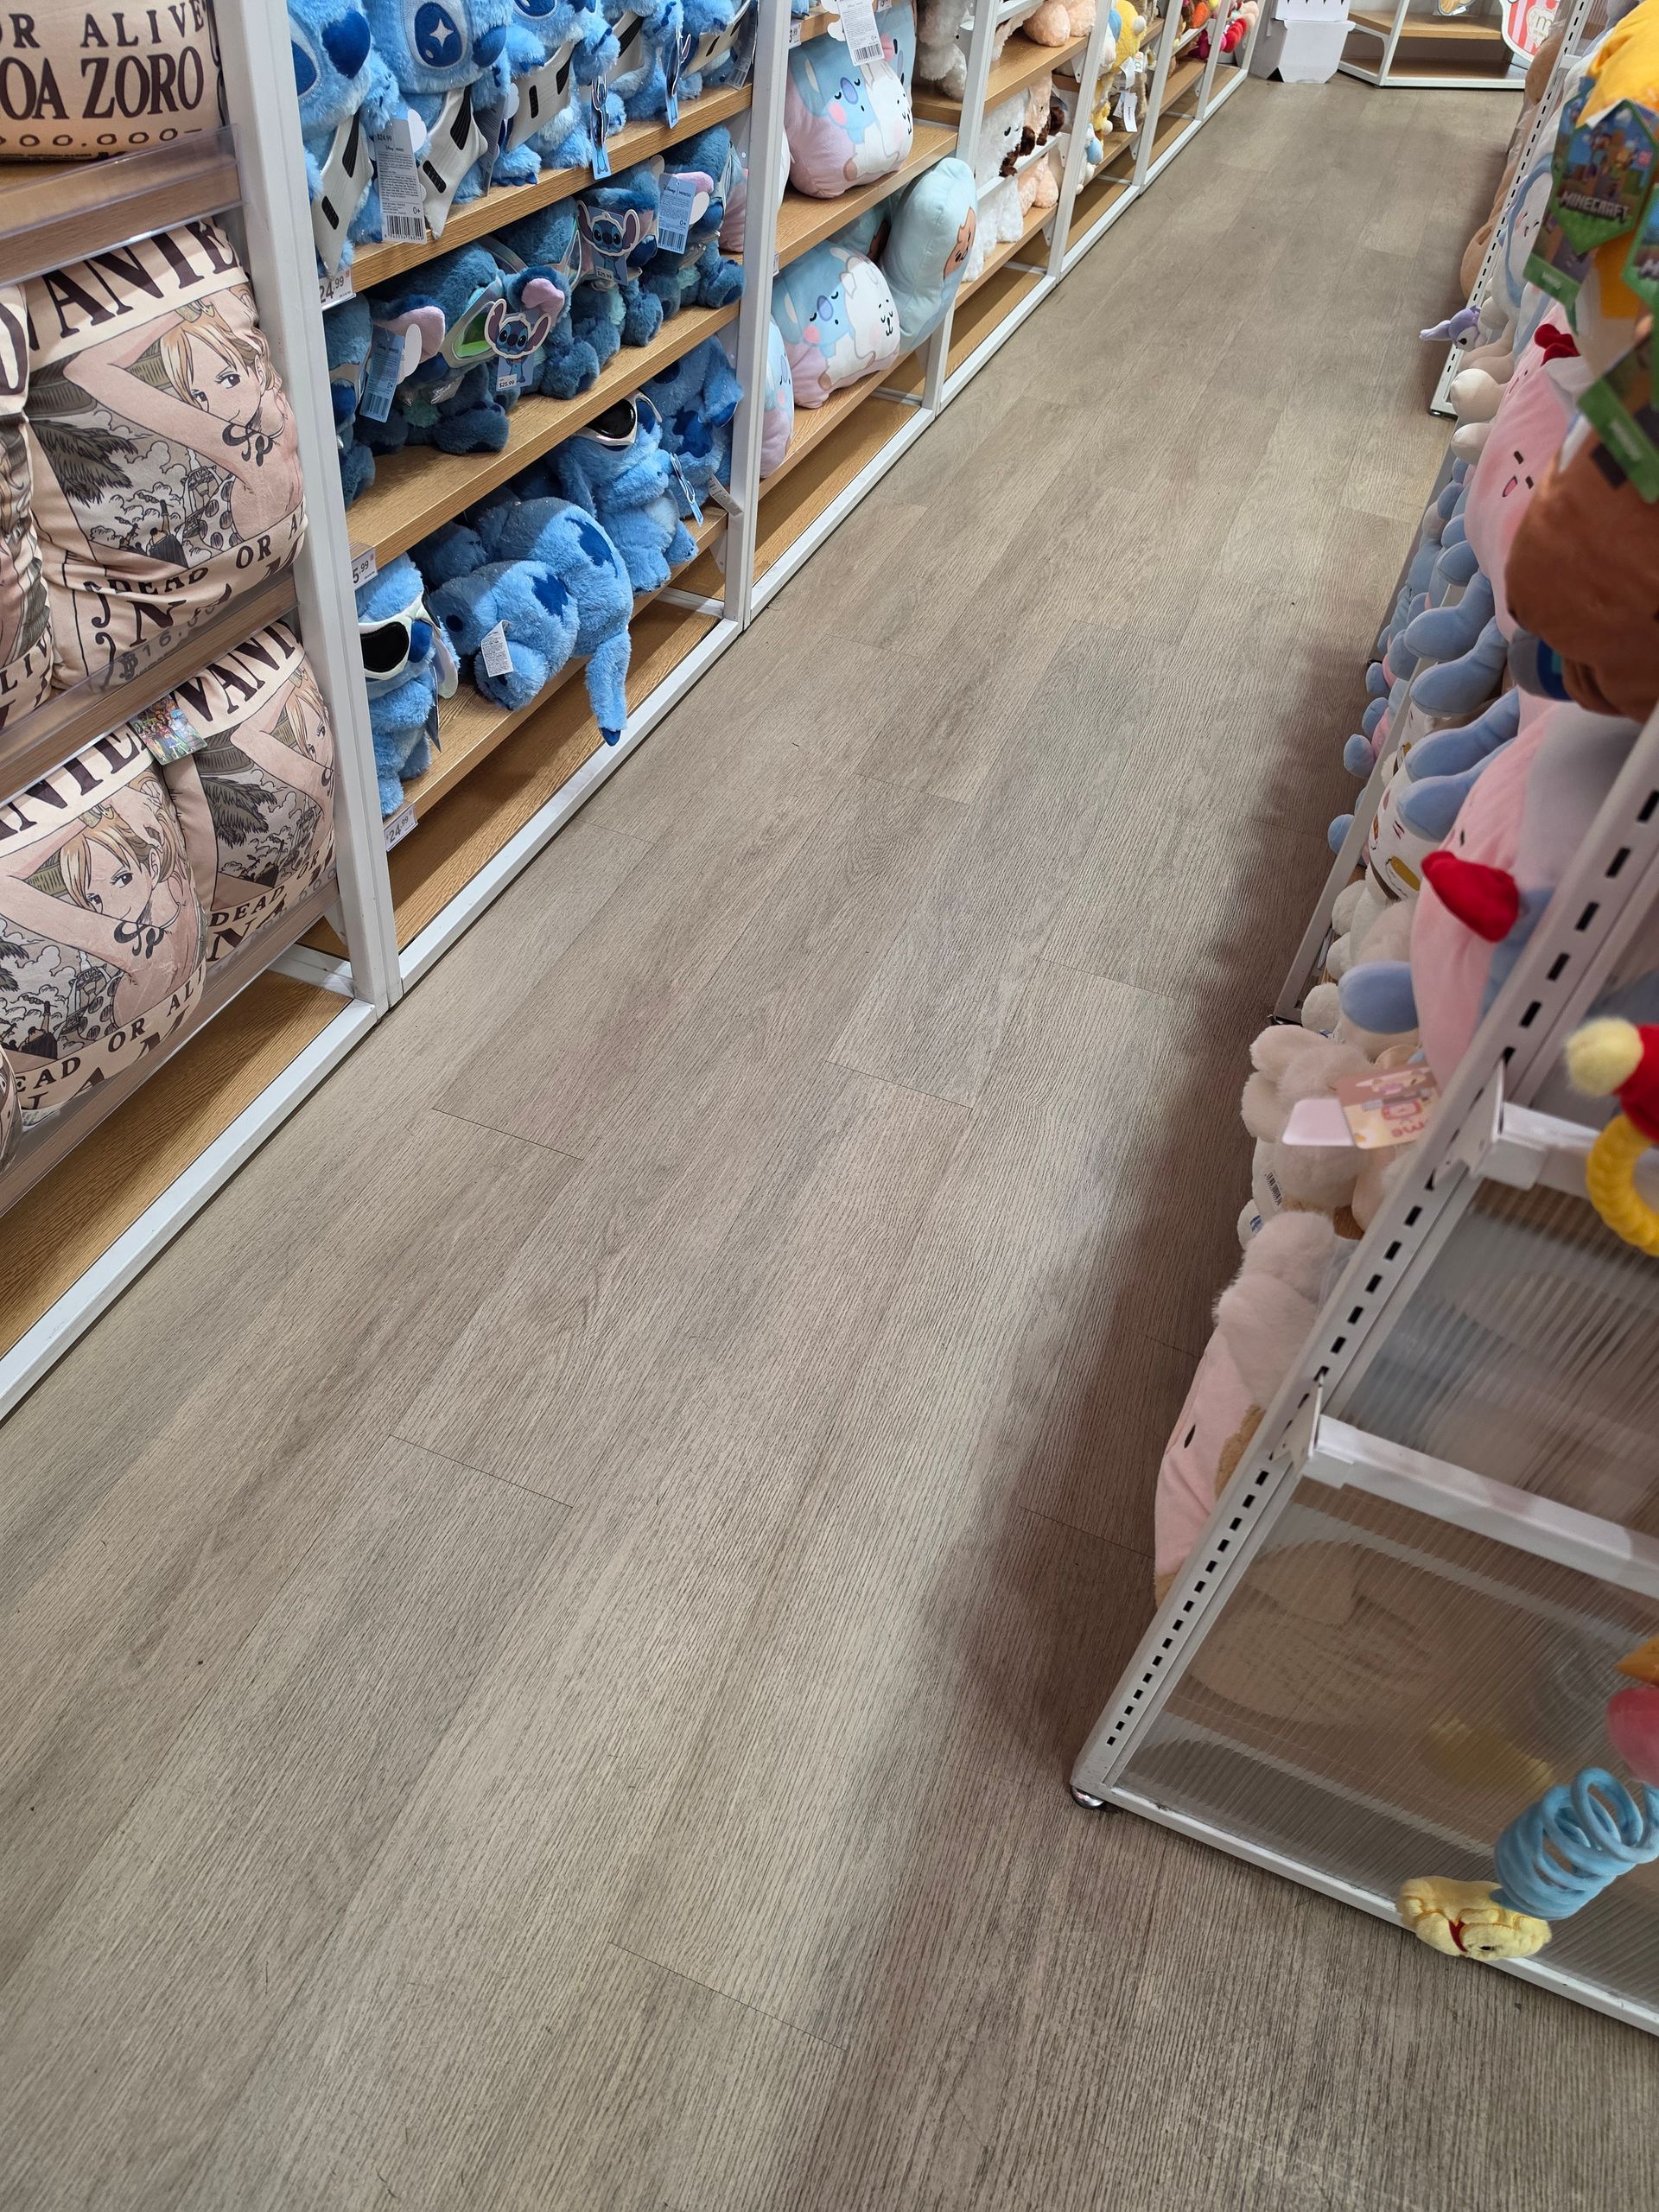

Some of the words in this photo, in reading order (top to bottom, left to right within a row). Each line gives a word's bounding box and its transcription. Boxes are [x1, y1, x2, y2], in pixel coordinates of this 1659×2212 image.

[80, 0, 204, 48] ALIVE
[81, 47, 204, 118] ZORO
[1560, 190, 1629, 224] MINECRAFT
[108, 567, 208, 596] DEAD
[236, 534, 271, 569] OR
[209, 885, 285, 927] DEAD
[108, 1017, 146, 1052] OR
